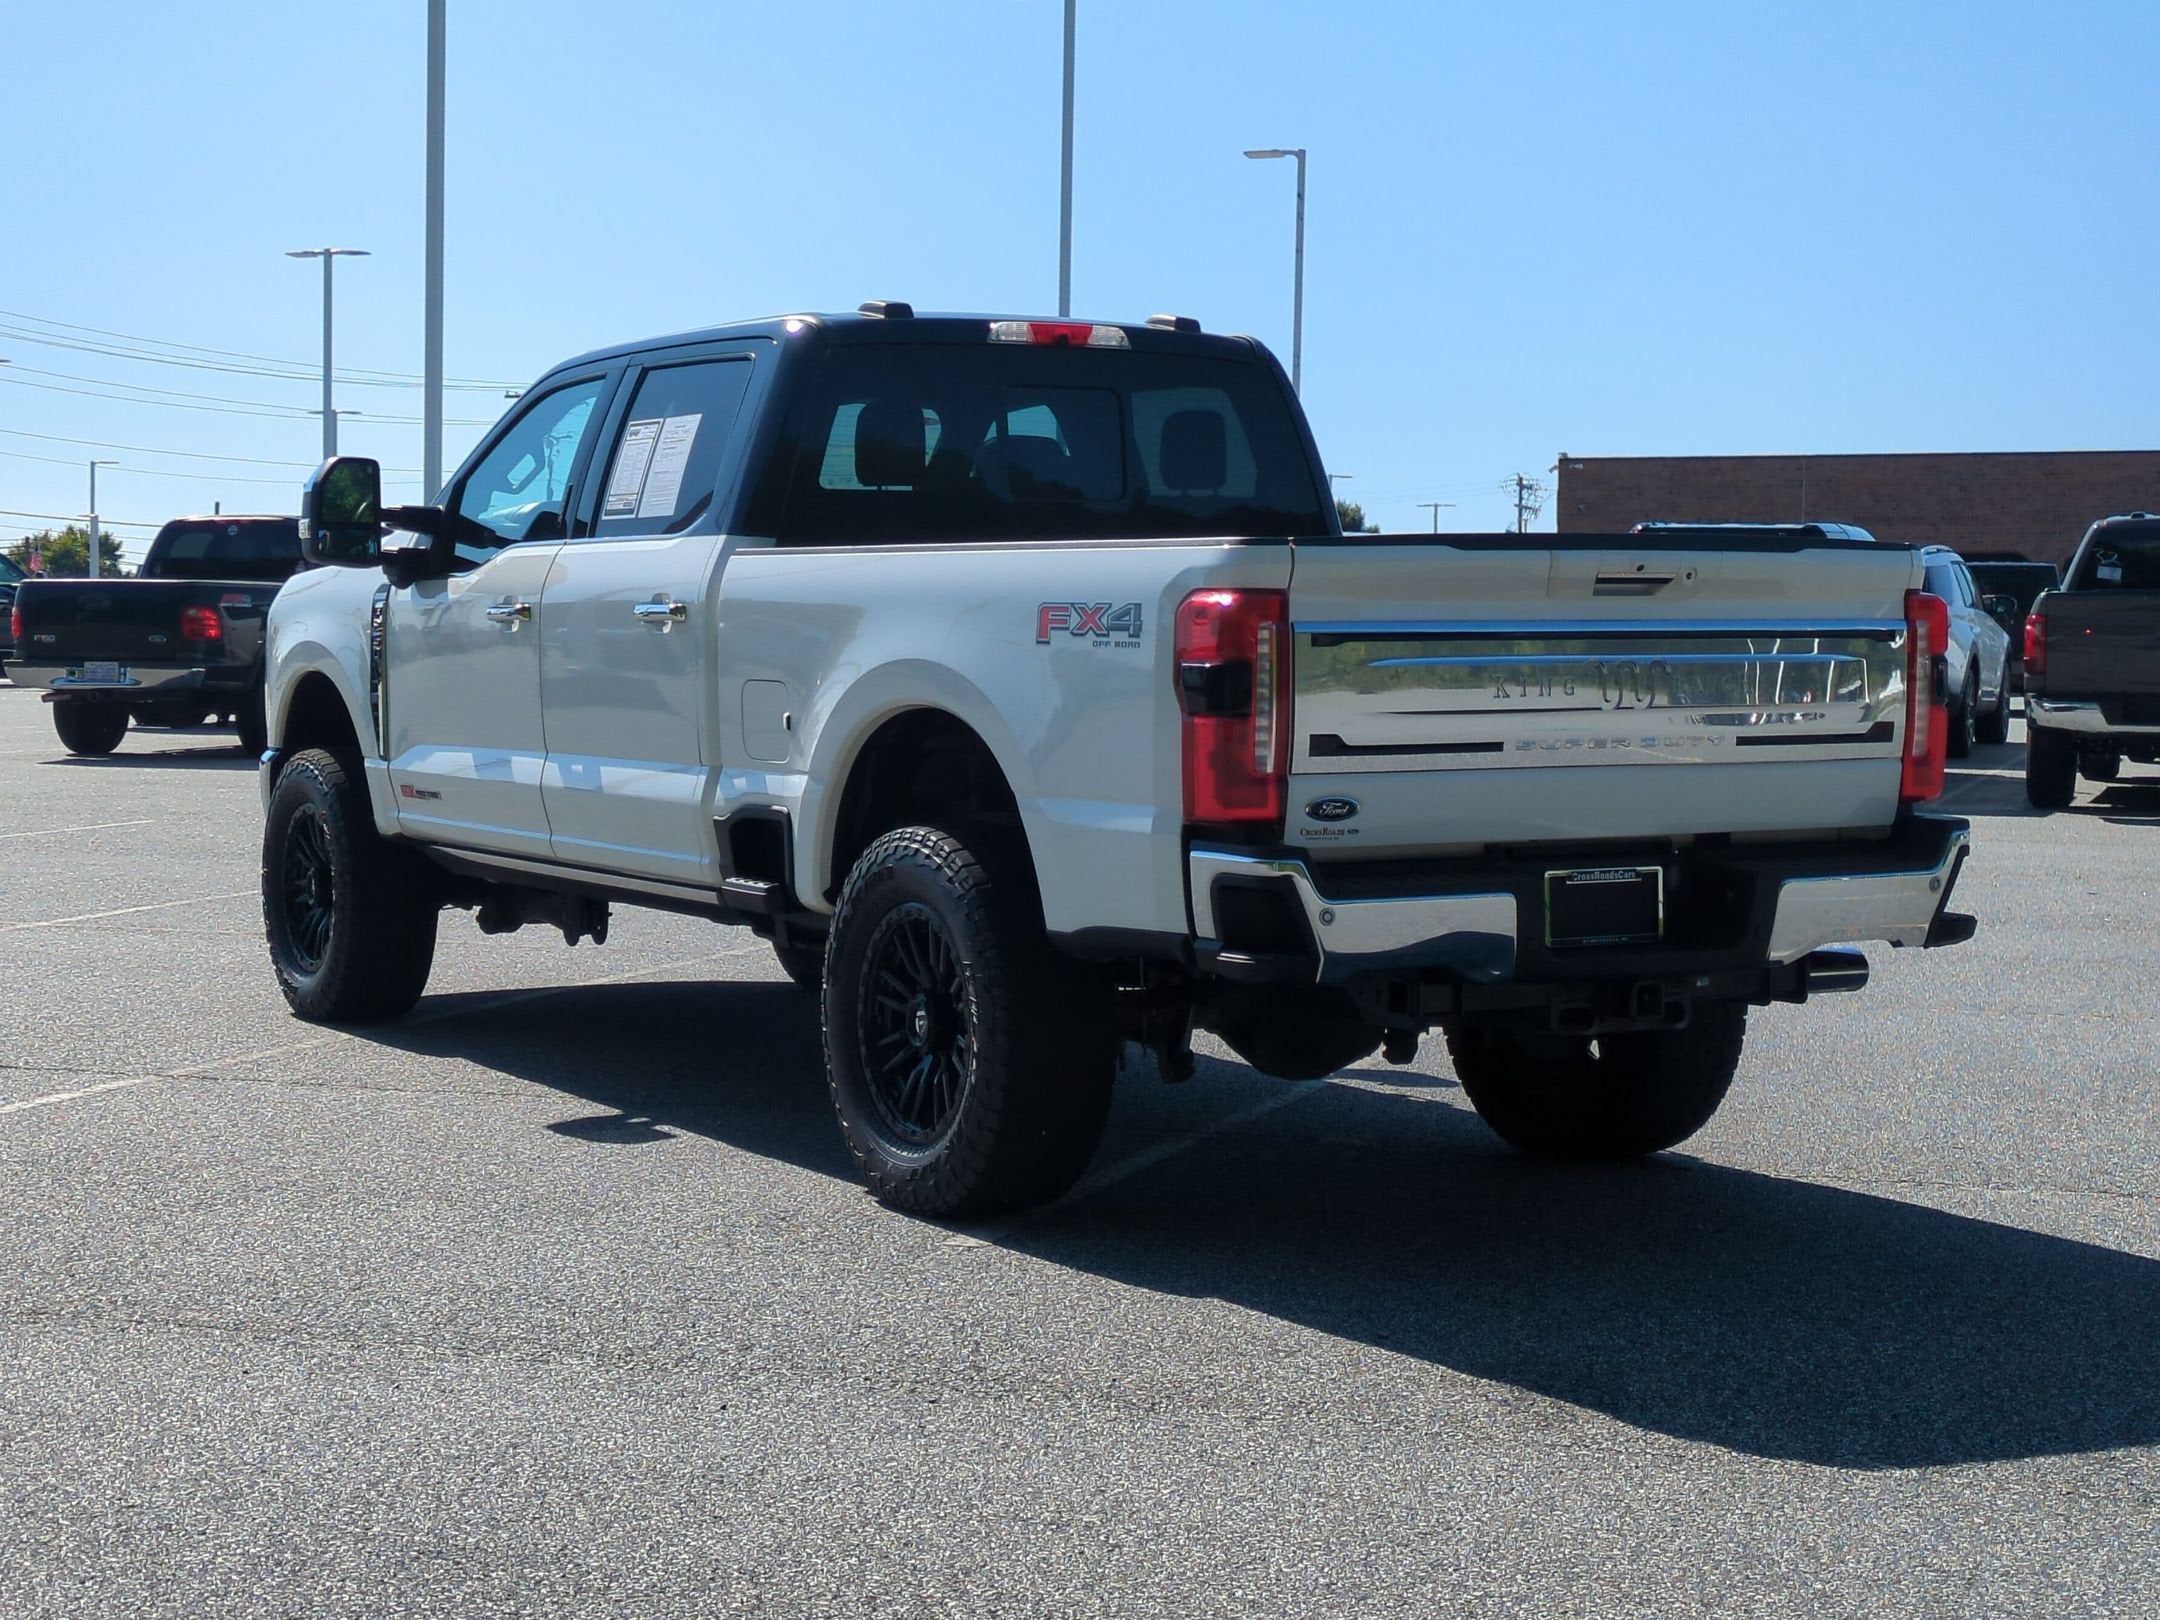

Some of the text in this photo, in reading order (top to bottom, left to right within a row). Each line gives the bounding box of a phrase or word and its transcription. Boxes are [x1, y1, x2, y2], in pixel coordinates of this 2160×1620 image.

[1036, 602, 1142, 645] FX4
[1092, 640, 1141, 649] OFF ROAD
[1491, 675, 1576, 699] KING
[1515, 735, 1725, 751] SUPER DUTY
[1572, 870, 1637, 881] CrossRoadsCars
